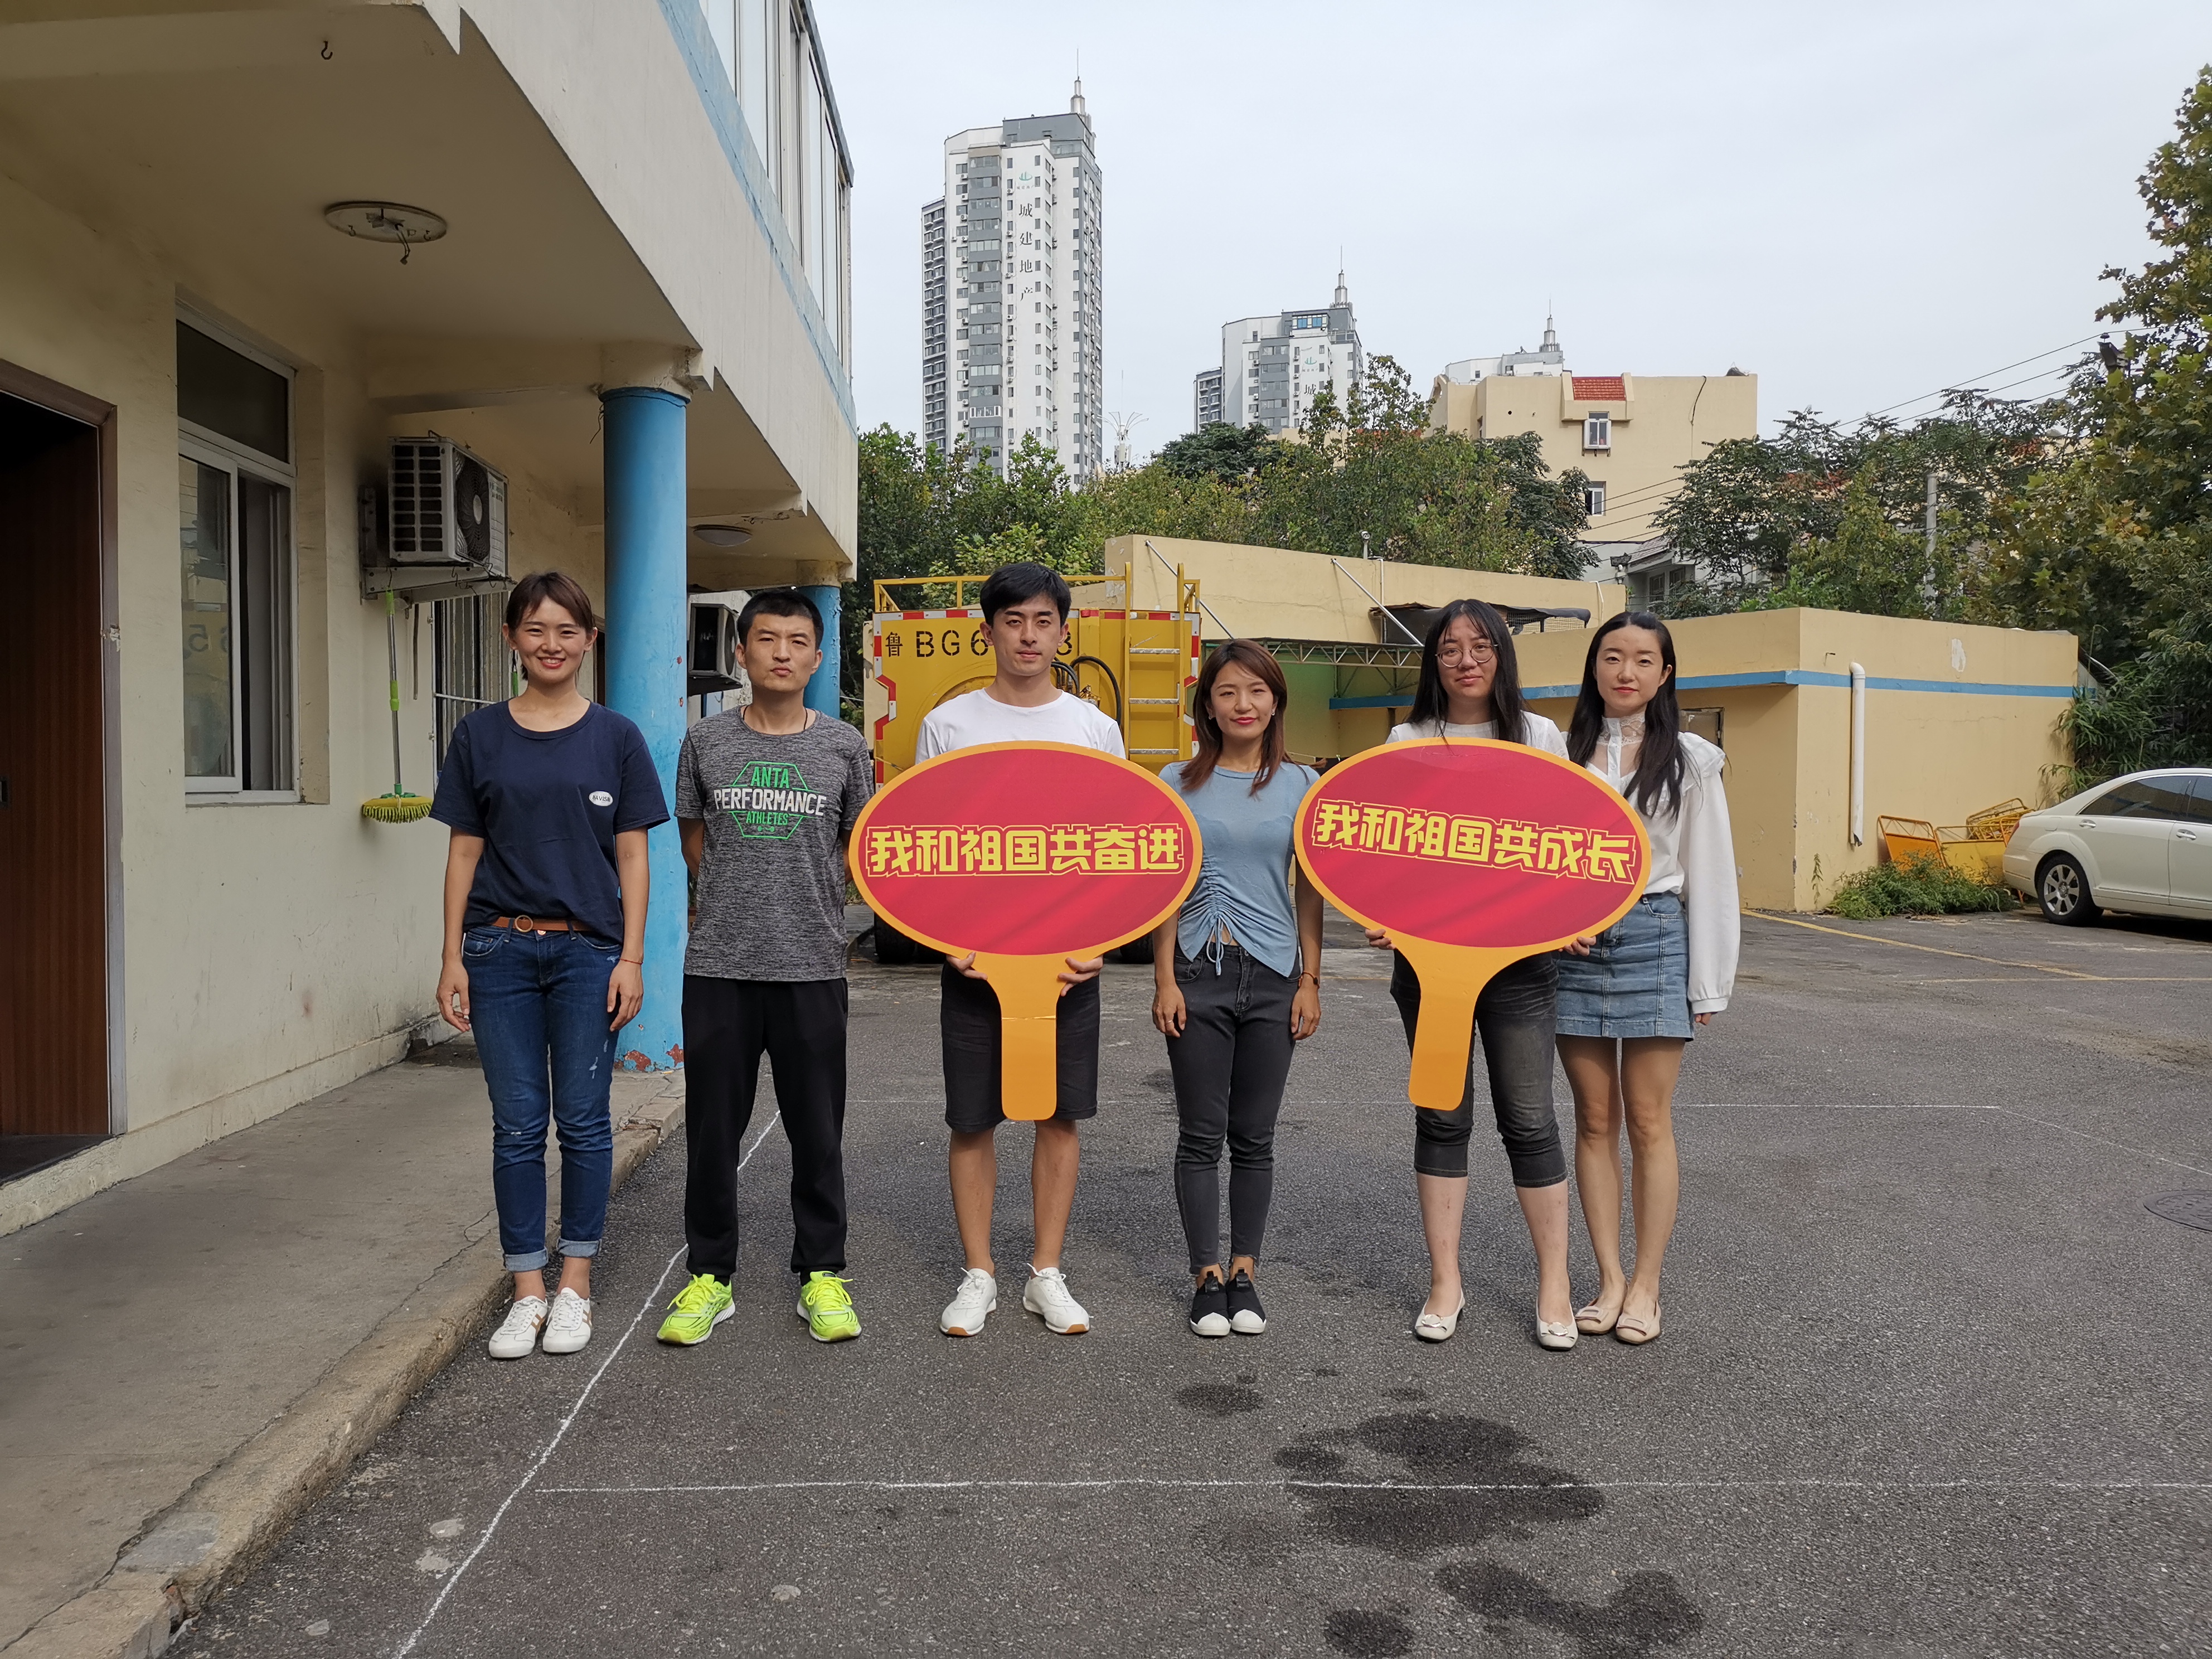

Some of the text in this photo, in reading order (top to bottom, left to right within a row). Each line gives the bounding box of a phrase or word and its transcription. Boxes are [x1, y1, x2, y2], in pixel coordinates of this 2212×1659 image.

[1019, 203, 1032, 301] 城建地产
[750, 767, 789, 788] ANTA
[714, 788, 827, 816] PERFORMANCE
[746, 811, 789, 825] ATHLETES
[870, 827, 1181, 874] 我和祖国共奋进
[1316, 802, 1631, 880] 我和祖国共成长
